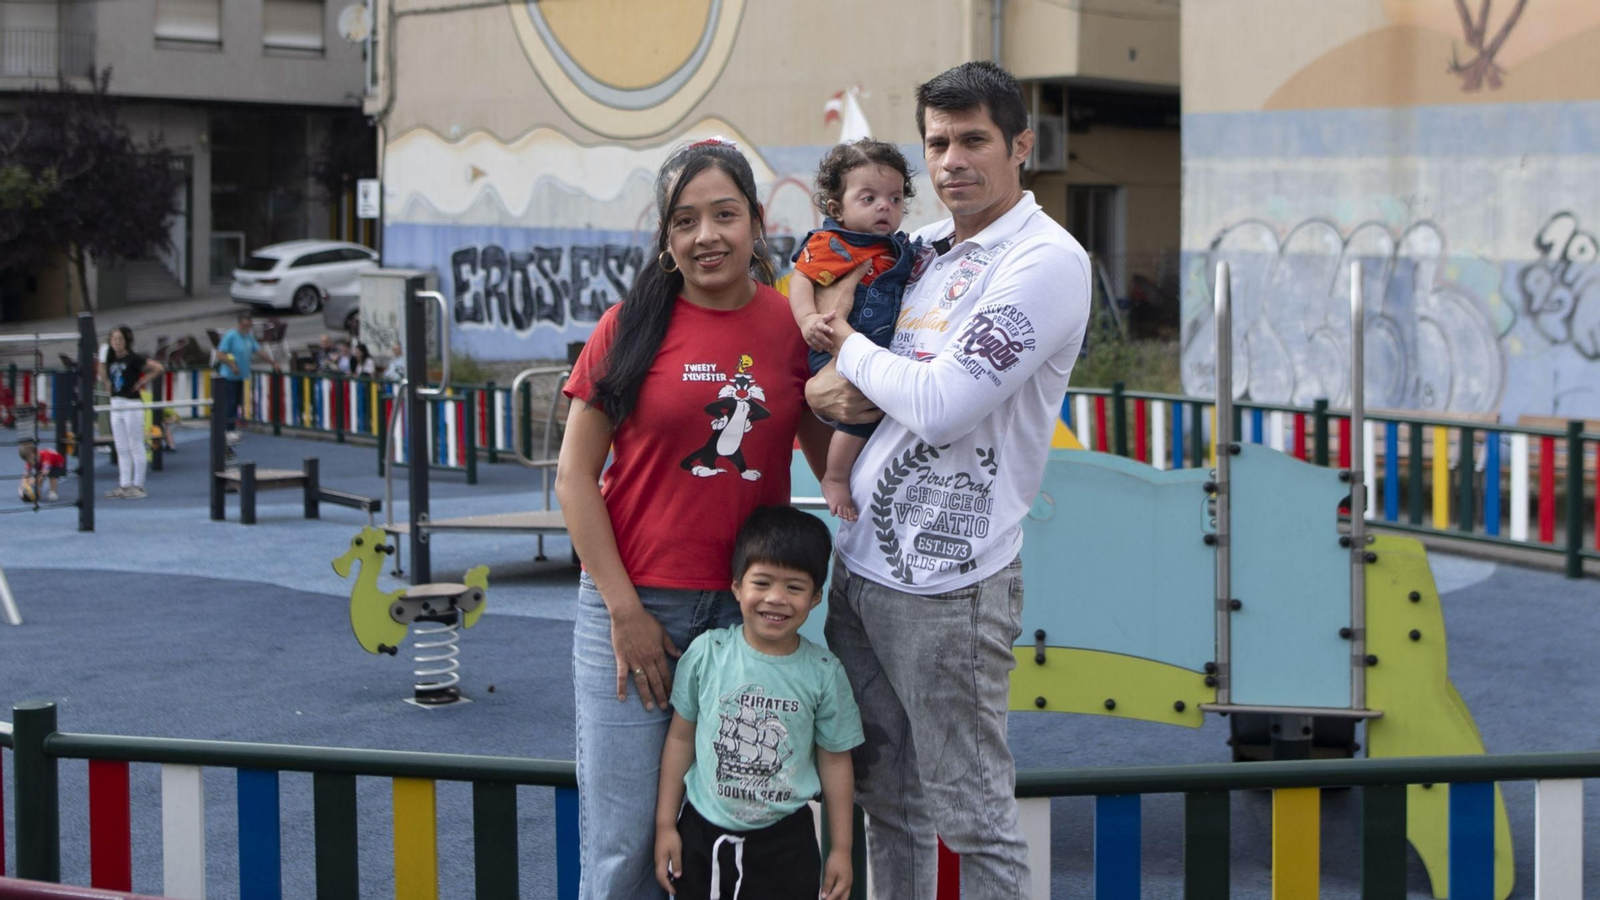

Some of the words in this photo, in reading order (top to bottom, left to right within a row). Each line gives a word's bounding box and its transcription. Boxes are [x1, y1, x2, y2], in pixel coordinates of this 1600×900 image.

[993, 315, 1020, 338] PREMIER
[896, 332, 914, 342] OR
[957, 314, 1025, 372] Rugby
[1023, 338, 1036, 352] OF
[684, 363, 717, 372] TWEETY
[682, 373, 727, 382] SYLVESTER
[986, 369, 1002, 388] WINNER
[915, 466, 954, 486] First
[894, 502, 990, 539] VOCATIO
[741, 694, 799, 712] PIRATES
[717, 783, 757, 801] SOUTH
[760, 789, 792, 803] SEAS
